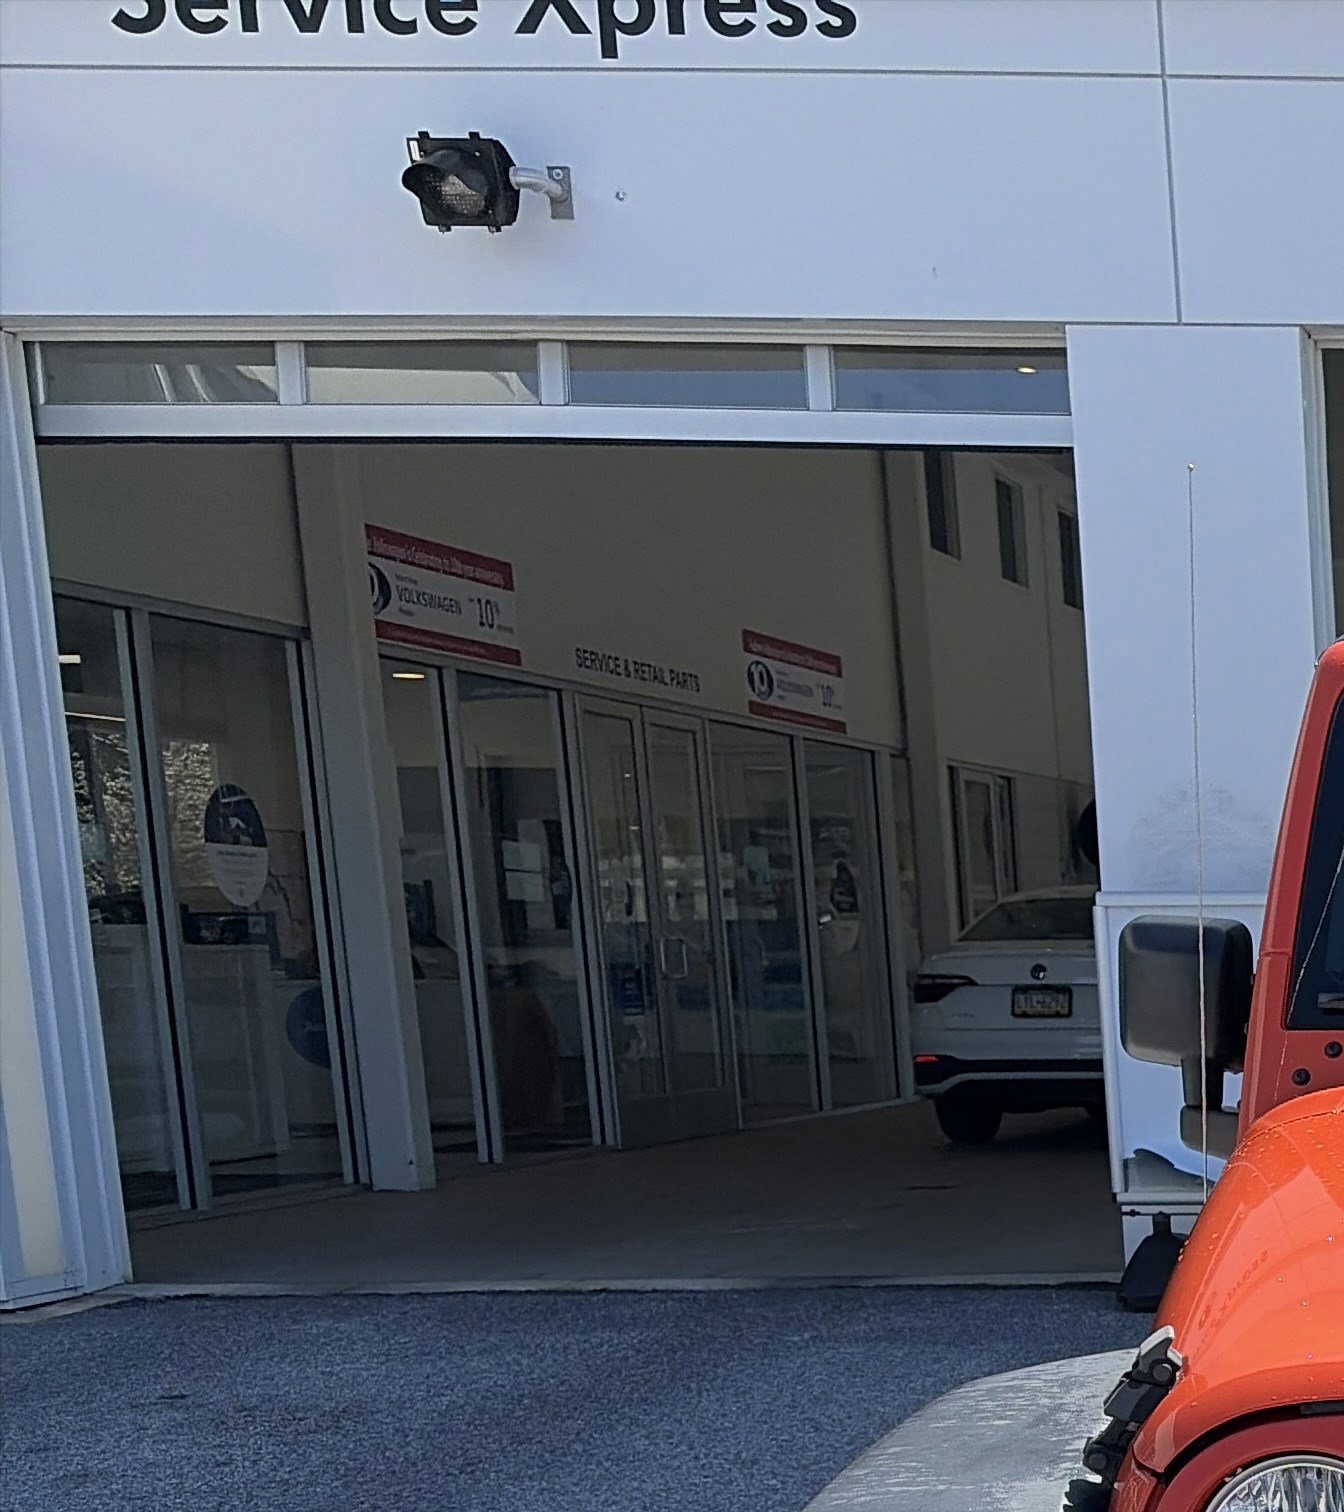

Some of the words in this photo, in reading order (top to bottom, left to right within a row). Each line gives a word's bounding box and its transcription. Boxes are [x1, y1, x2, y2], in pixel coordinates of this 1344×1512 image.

[396, 584, 462, 615] VOLKSWAGEN
[575, 647, 622, 676] SERVICE
[632, 659, 668, 686] RETAIL
[669, 668, 700, 693] PARTS
